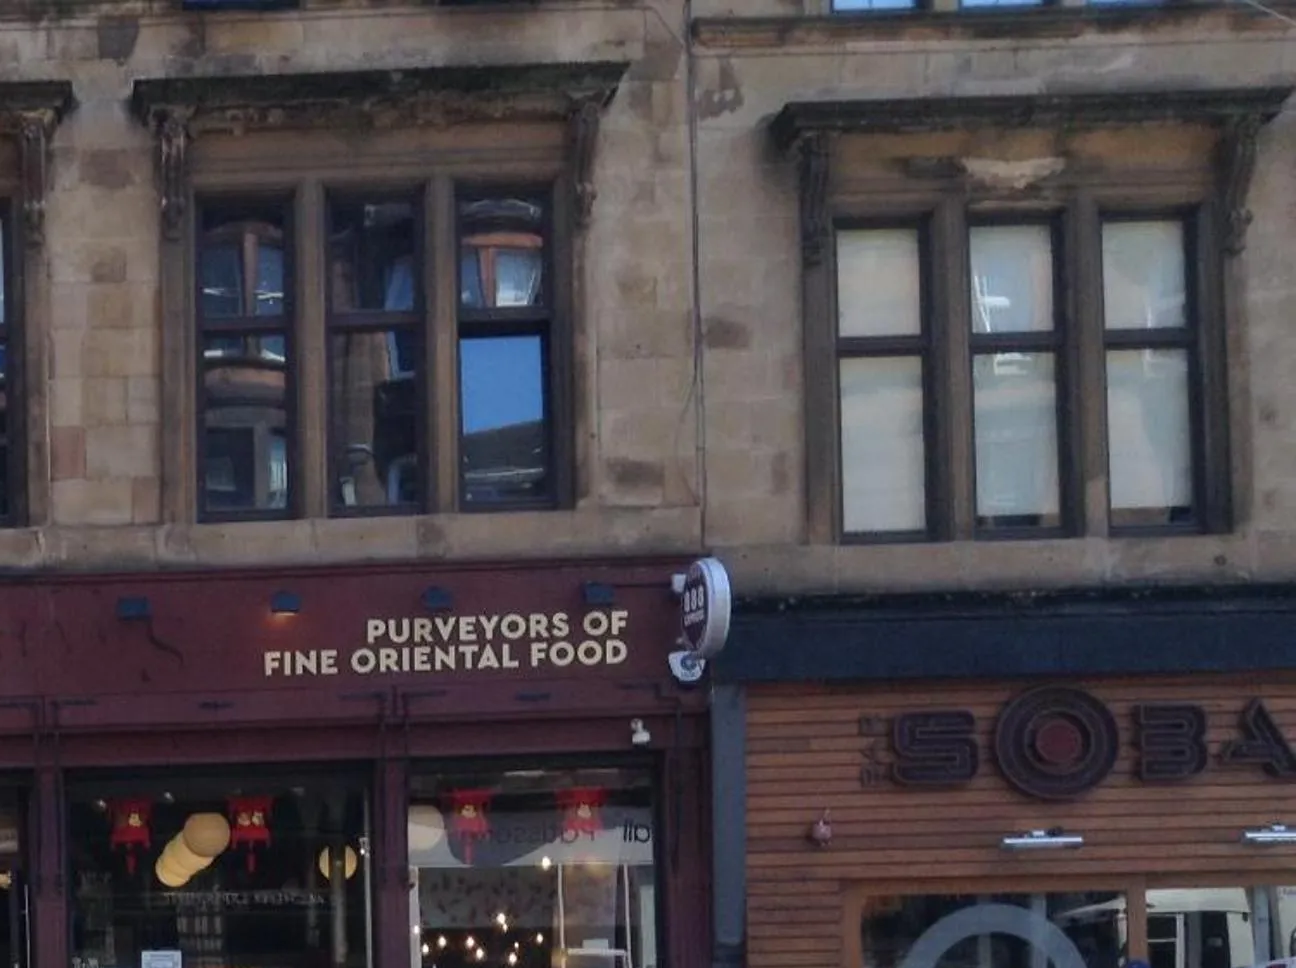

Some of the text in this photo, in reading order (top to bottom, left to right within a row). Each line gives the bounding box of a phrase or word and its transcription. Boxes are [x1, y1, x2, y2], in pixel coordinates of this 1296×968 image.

[367, 611, 629, 643] PURVEYORS OF
[264, 640, 628, 675] FINE ORIENTAL FOOD
[891, 685, 1296, 799] SOBA
